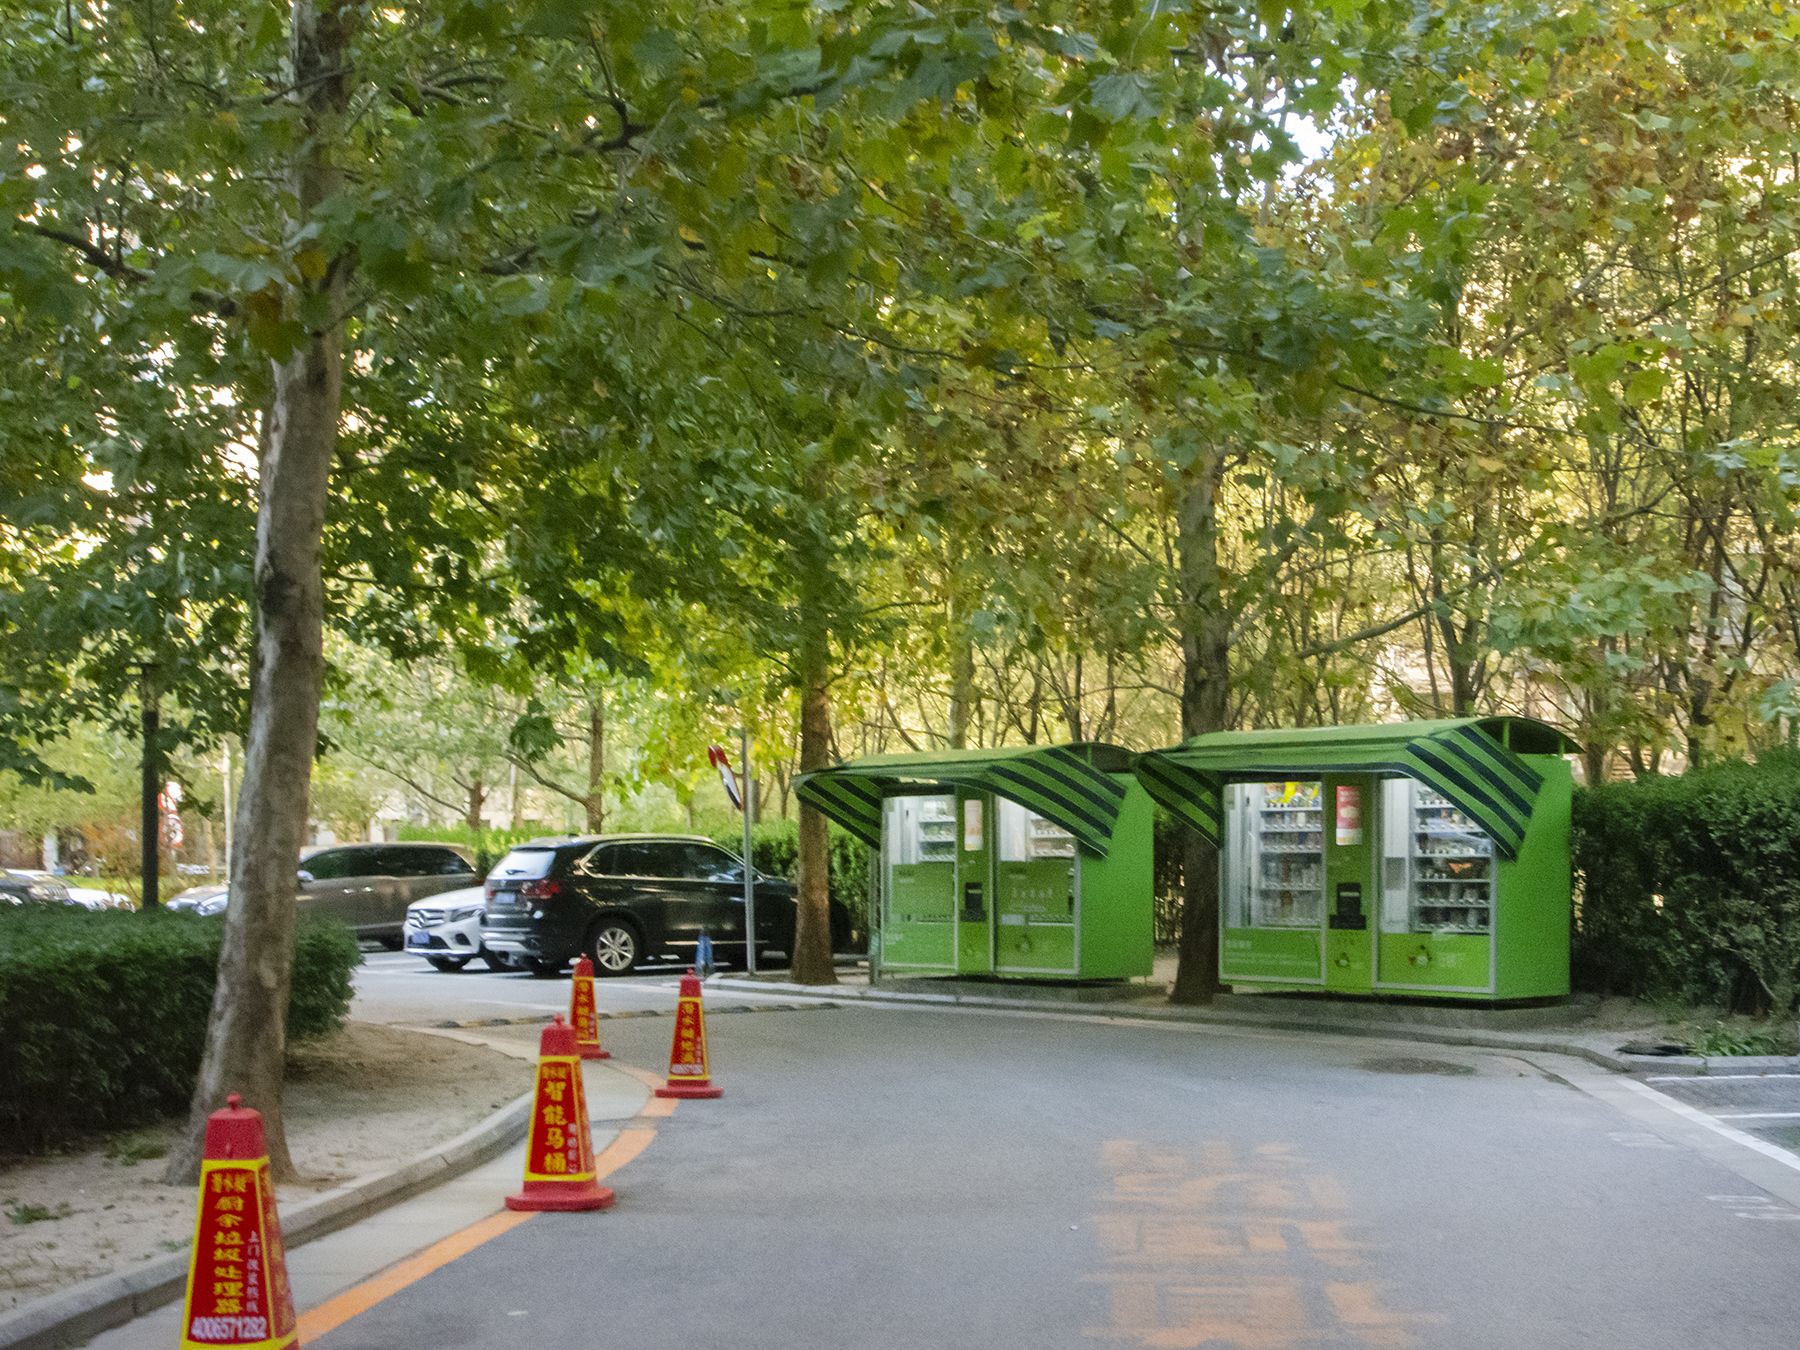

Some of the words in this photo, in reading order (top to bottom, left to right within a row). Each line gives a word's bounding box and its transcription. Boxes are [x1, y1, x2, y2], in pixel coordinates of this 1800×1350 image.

[542, 1081, 568, 1172] 智能马桶
[212, 1196, 245, 1314] 厨余垃圾处理器
